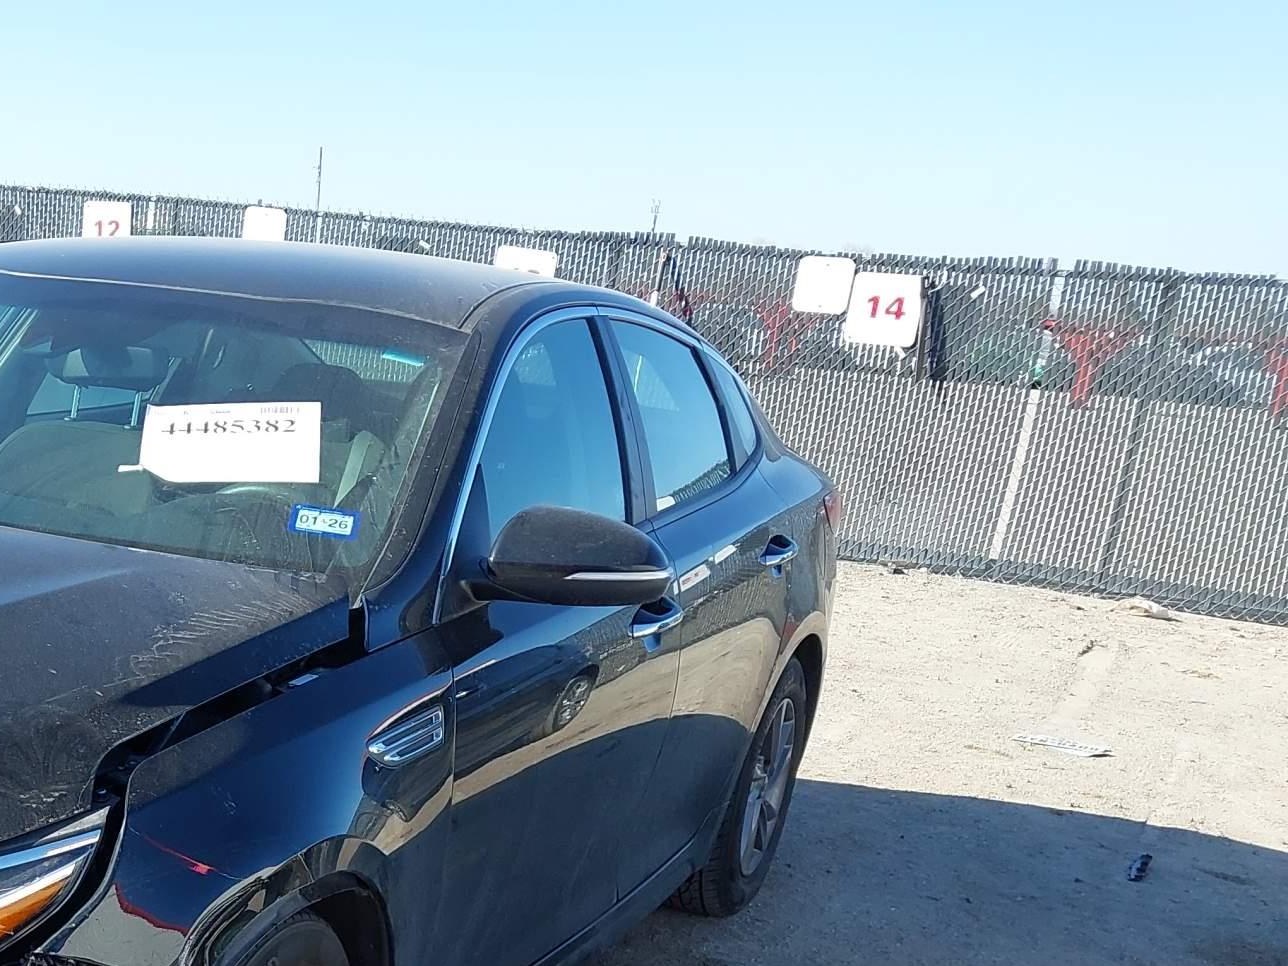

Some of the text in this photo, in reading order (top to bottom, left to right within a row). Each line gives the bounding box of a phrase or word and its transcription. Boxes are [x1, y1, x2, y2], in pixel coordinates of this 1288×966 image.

[94, 220, 120, 237] 12
[867, 295, 907, 320] 14
[161, 419, 296, 435] 44485382
